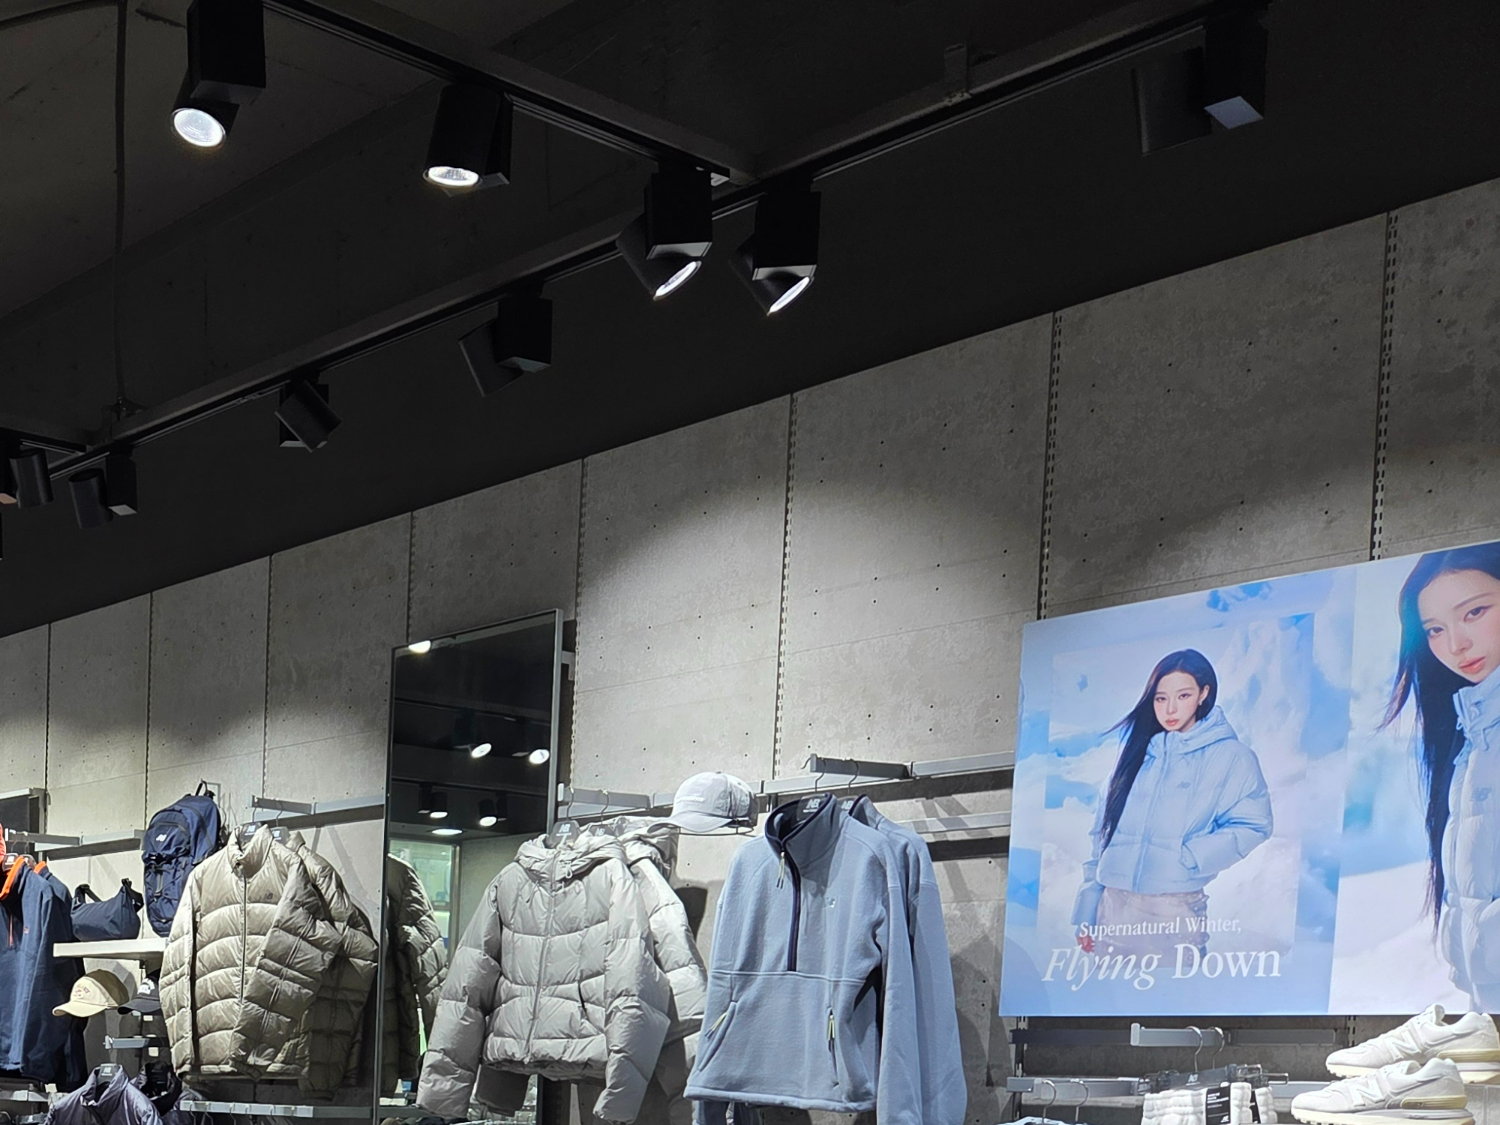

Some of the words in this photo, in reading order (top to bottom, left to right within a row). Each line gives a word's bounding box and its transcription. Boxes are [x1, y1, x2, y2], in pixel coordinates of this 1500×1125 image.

[1078, 917, 1181, 942] Supernatural
[1185, 915, 1242, 936] Winter,
[1040, 944, 1162, 991] Flying
[1172, 943, 1282, 980] Down
